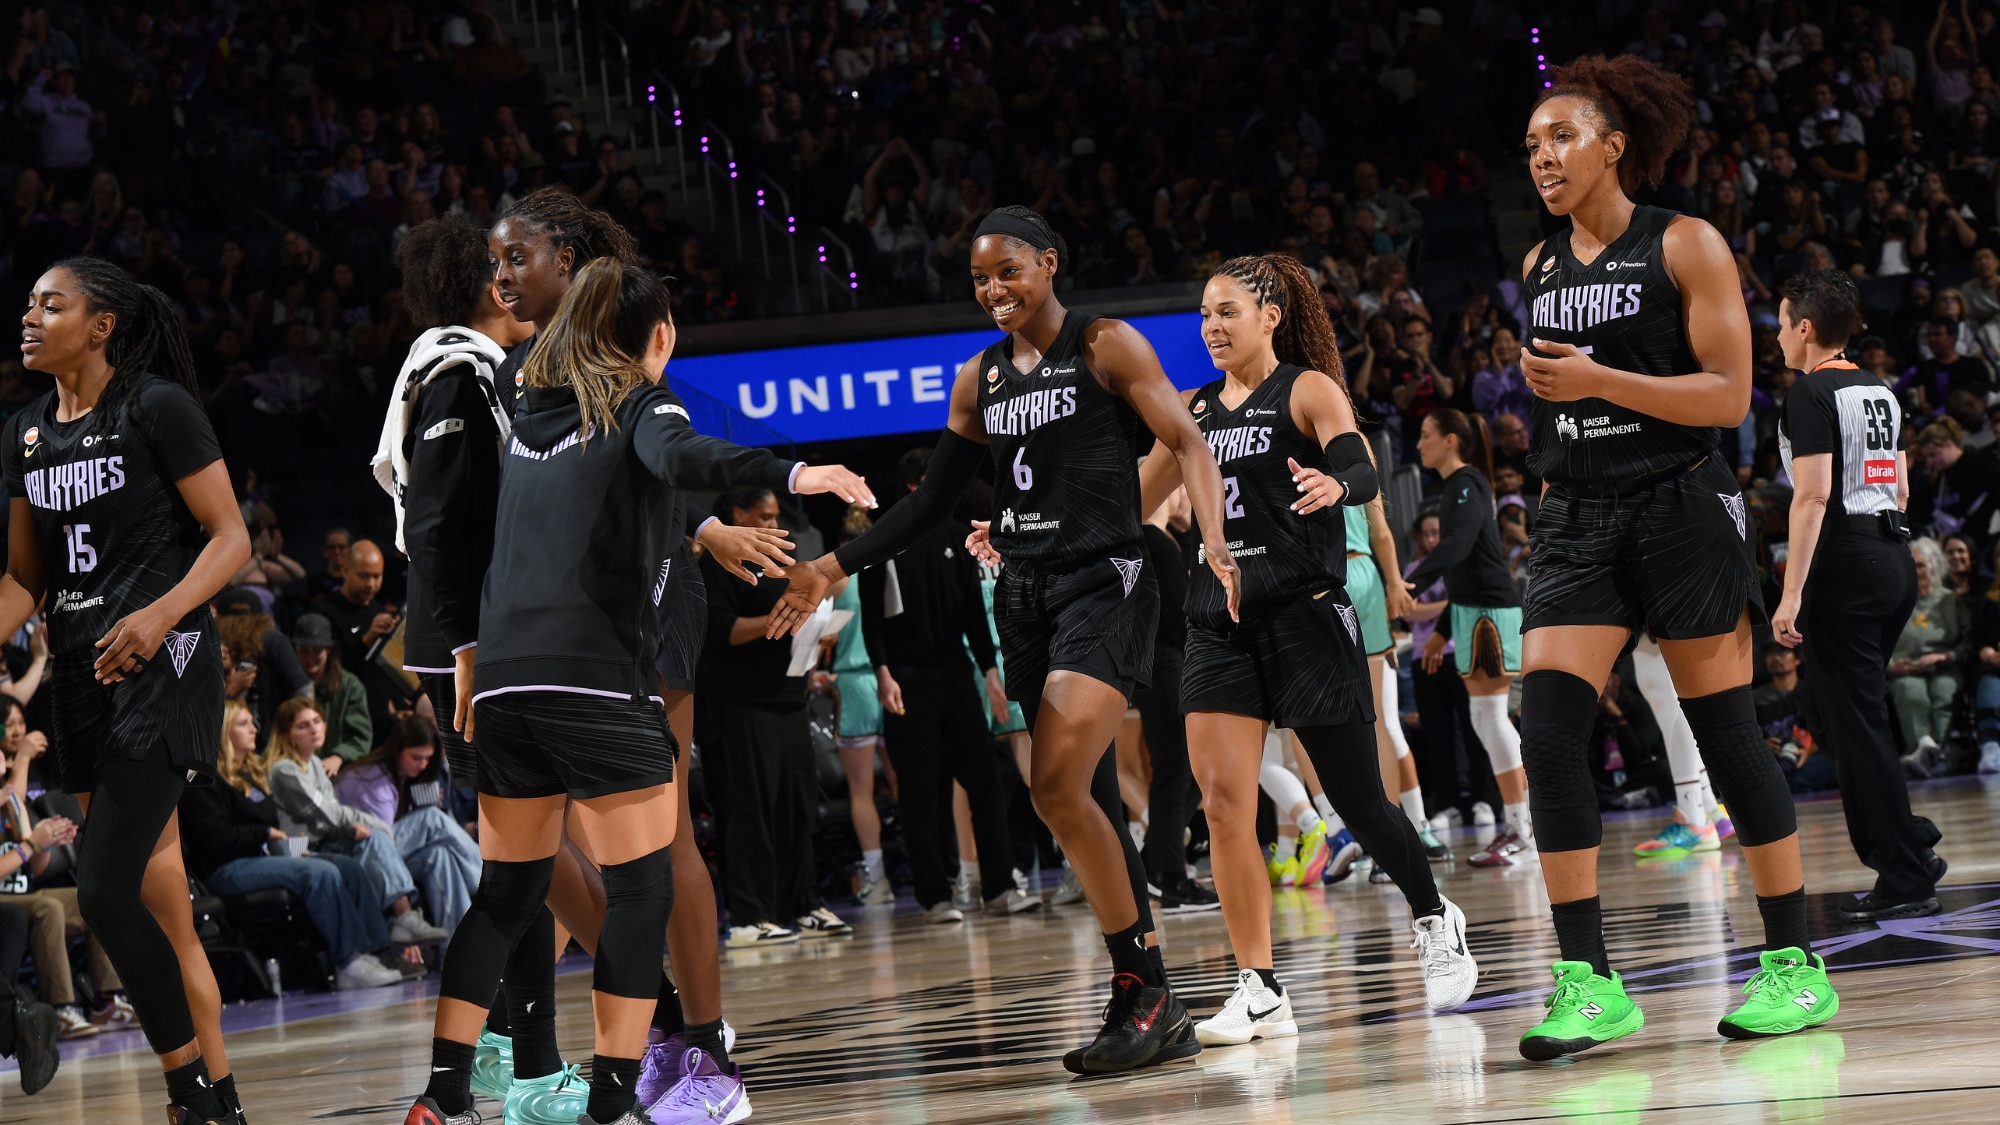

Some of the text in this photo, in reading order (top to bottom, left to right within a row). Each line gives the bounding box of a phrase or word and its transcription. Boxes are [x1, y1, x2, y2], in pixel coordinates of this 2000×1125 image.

[1618, 260, 1647, 269] freedom
[1533, 283, 1642, 332] VALKYRIES
[1052, 366, 1076, 376] freedom
[738, 363, 965, 419] UNITE
[984, 386, 1077, 435] VALKYRIES
[427, 420, 460, 437] IREN
[1582, 416, 1610, 427] KAISER
[1583, 423, 1642, 439] PERMANENTE
[1863, 398, 1893, 450] 33
[1203, 426, 1273, 466] KYRIES
[1013, 446, 1033, 491] 6
[24, 455, 126, 511] VALKYRIES
[1018, 513, 1041, 521] KAISER
[1020, 520, 1060, 531] PERMANENTE
[63, 523, 97, 573] 15
[1226, 540, 1244, 549] AISER
[1230, 546, 1267, 558] RMANENTE
[1792, 988, 1819, 1013] N
[1578, 1001, 1605, 1021] N
